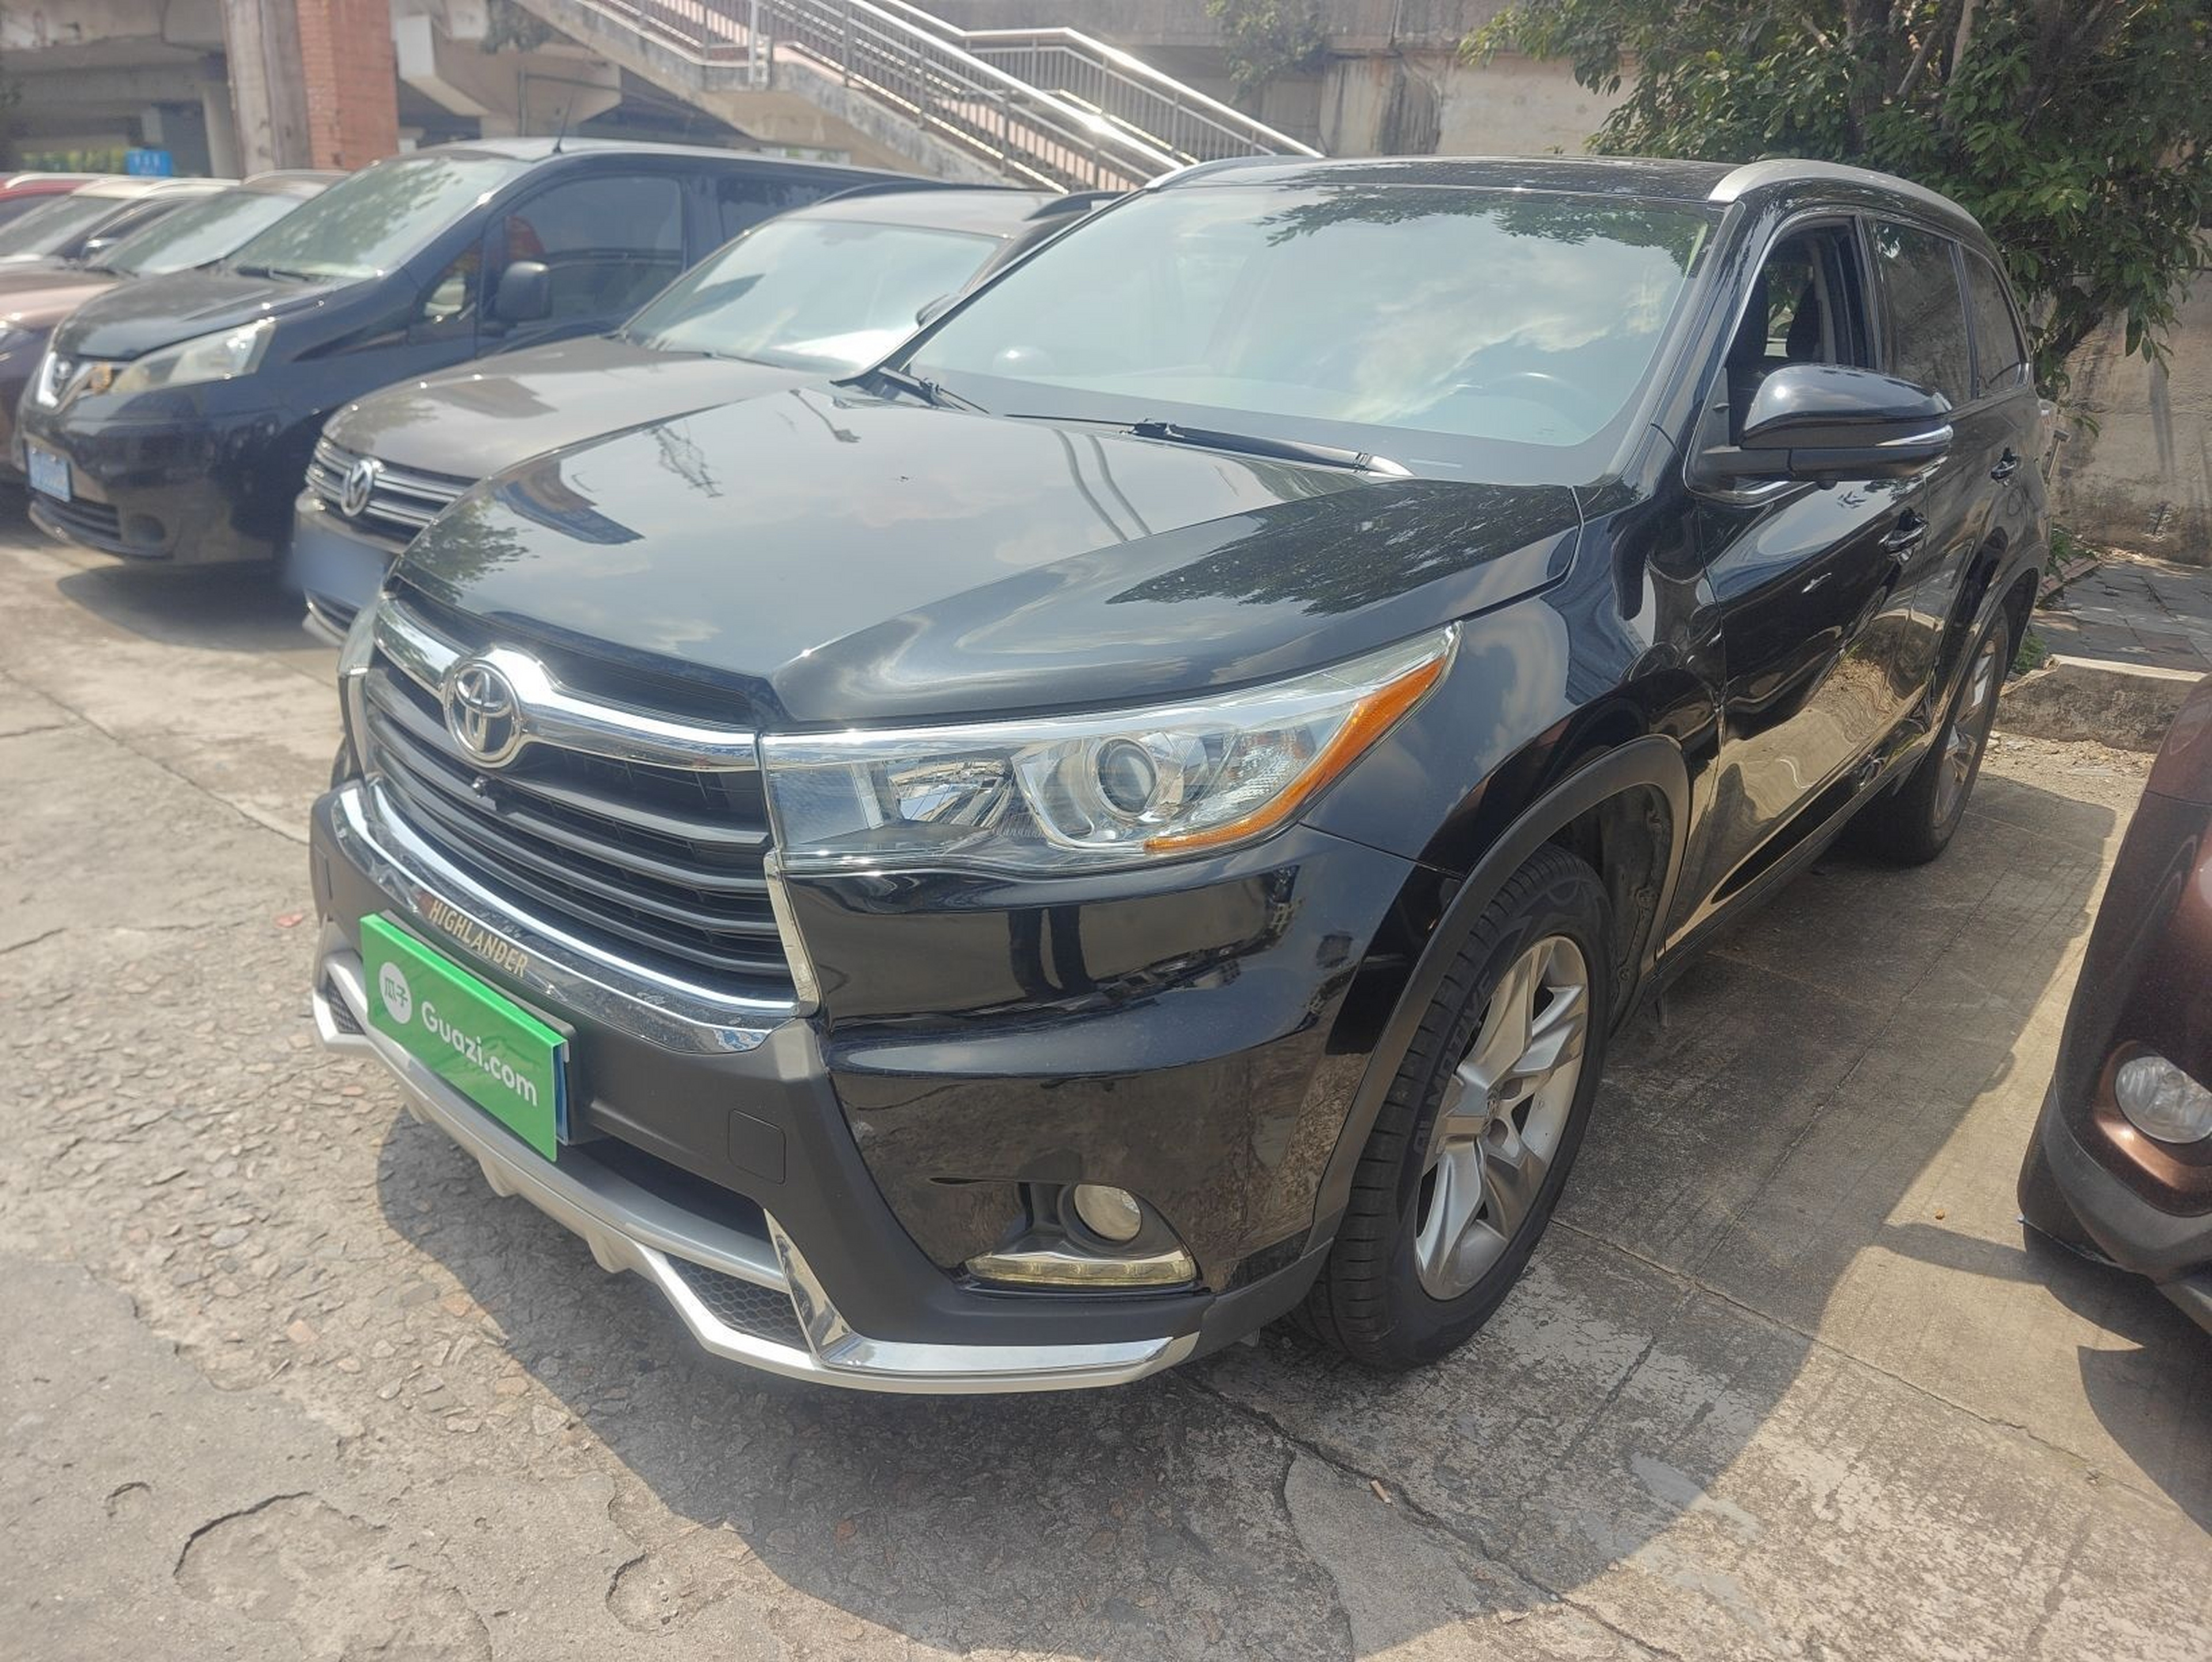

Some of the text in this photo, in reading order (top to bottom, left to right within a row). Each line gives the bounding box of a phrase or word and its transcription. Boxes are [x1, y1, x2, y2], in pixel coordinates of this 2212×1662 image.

[429, 900, 529, 978] HIGHLANDER
[384, 976, 408, 1008] 瓜子
[421, 1001, 539, 1107] Guazi.com
